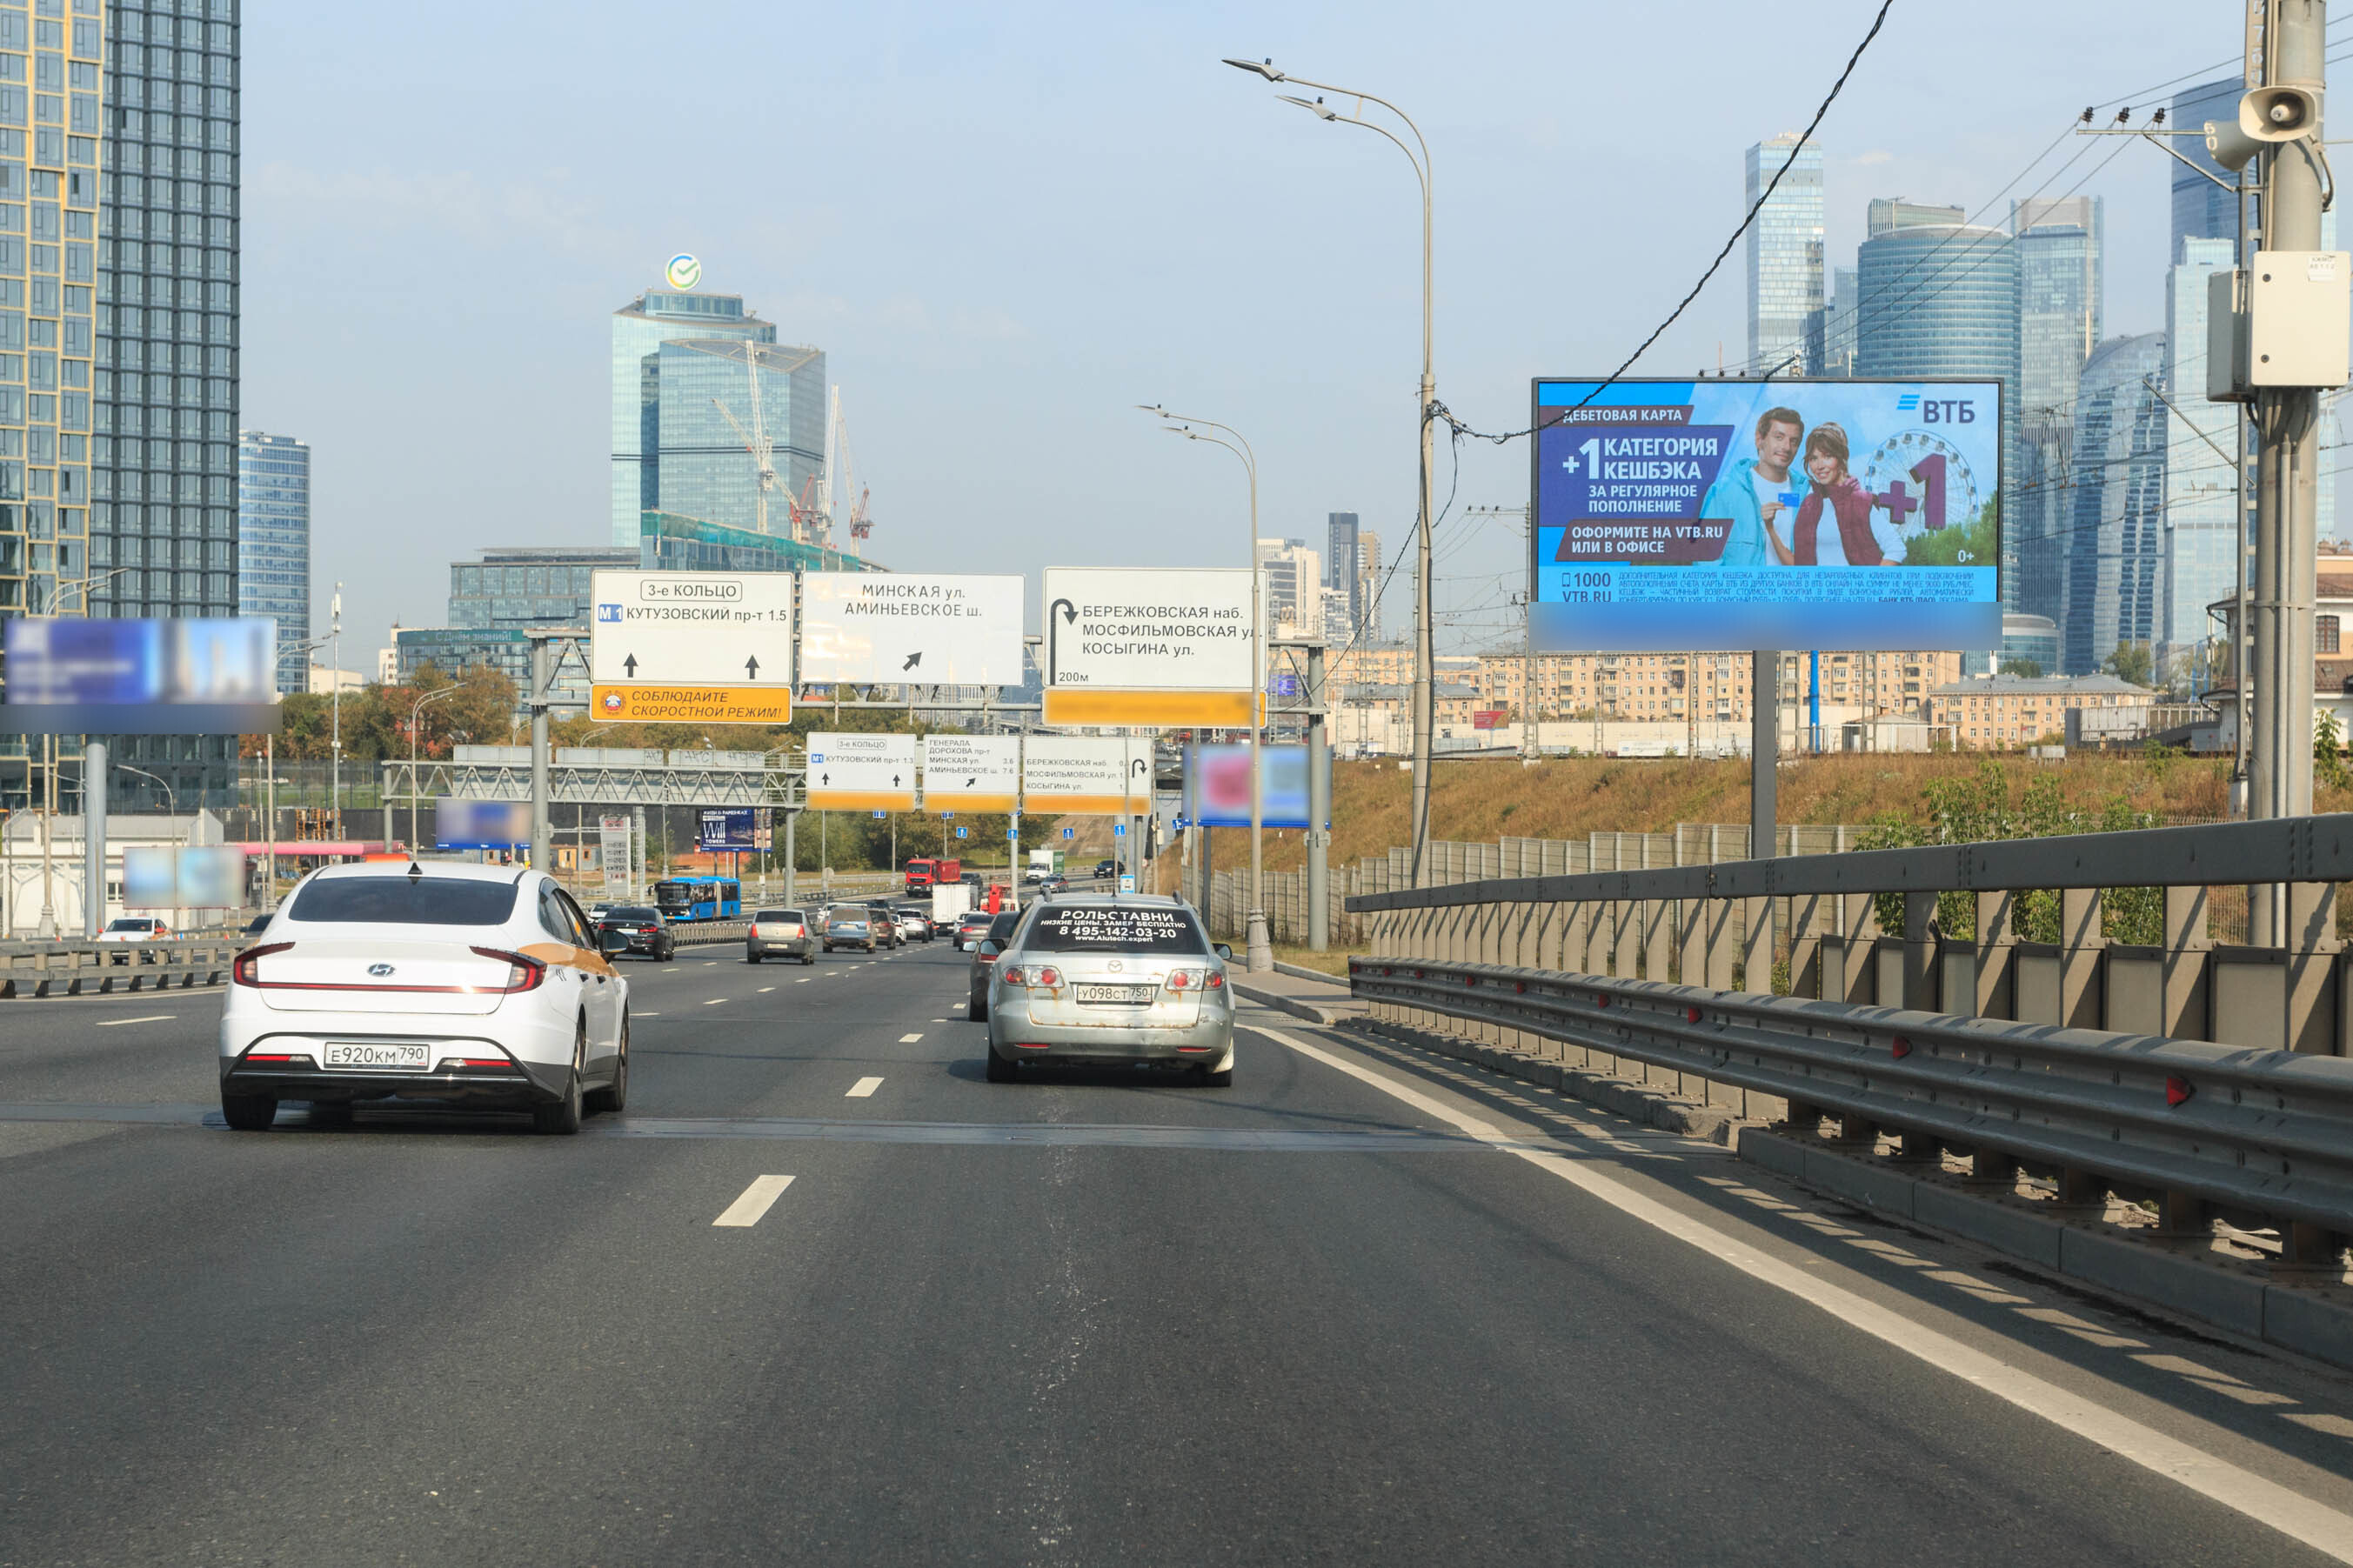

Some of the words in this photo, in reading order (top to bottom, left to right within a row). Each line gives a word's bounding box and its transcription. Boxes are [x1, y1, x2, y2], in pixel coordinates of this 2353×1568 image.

[1563, 410, 1637, 424] ДЕБЕТОВАЯ
[1641, 410, 1682, 422] КАРТА
[1922, 400, 1975, 424] ВТБ
[1604, 437, 1718, 457] КАТЕГОРИЯ
[1604, 461, 1702, 480] КЕШБЭКА
[1588, 484, 1607, 497] ЗА
[1611, 484, 1698, 497] РЕГУЛЯРНОЕ
[1588, 500, 1682, 513] ПОПОЛНЕНИЕ
[1572, 526, 1648, 538] ОФОРМИТЕ
[1653, 526, 1672, 538] НА
[1675, 526, 1723, 538] VTB.RU
[1572, 541, 1601, 553] ИЛИ
[1604, 541, 1613, 553] В
[1616, 541, 1665, 553] ОФИСЕ
[1957, 550, 1975, 563] 0+
[1574, 572, 1611, 587] 1000
[647, 584, 670, 597] 3-е
[673, 584, 738, 598] КОЛЬЦО
[862, 584, 941, 598] МИНСКАЯ
[945, 588, 966, 602] ул.
[1562, 591, 1612, 602] VTB.RU
[626, 607, 731, 621] КУТУЗОВСКИЙ
[734, 612, 763, 623] пр-т
[769, 611, 787, 621] 1.5
[845, 602, 962, 617] АМИНЬЕВСКОЕ
[966, 606, 983, 617] ш.
[1082, 605, 1209, 619] БЕРЕЖКОВСКАЯ
[1213, 607, 1244, 619] наб.
[1082, 624, 1237, 637] МОСФИЛЬМОВСКАЯ
[1082, 643, 1169, 656] КОСЫГИНА
[1173, 644, 1195, 657] ул.
[1059, 671, 1089, 683] 200м
[632, 690, 730, 704] СОБЛЮДАЙТЕ
[632, 704, 725, 718] СКОРОСТНОЙ
[727, 706, 782, 718] РЕЖИМ!
[826, 755, 882, 764] КУТУЗОВСКИЙ
[703, 822, 725, 838] Will
[1060, 911, 1174, 922] РОЛЬСТАВНИ
[1059, 926, 1069, 936] 8
[1072, 927, 1177, 938] 495-142-03-20
